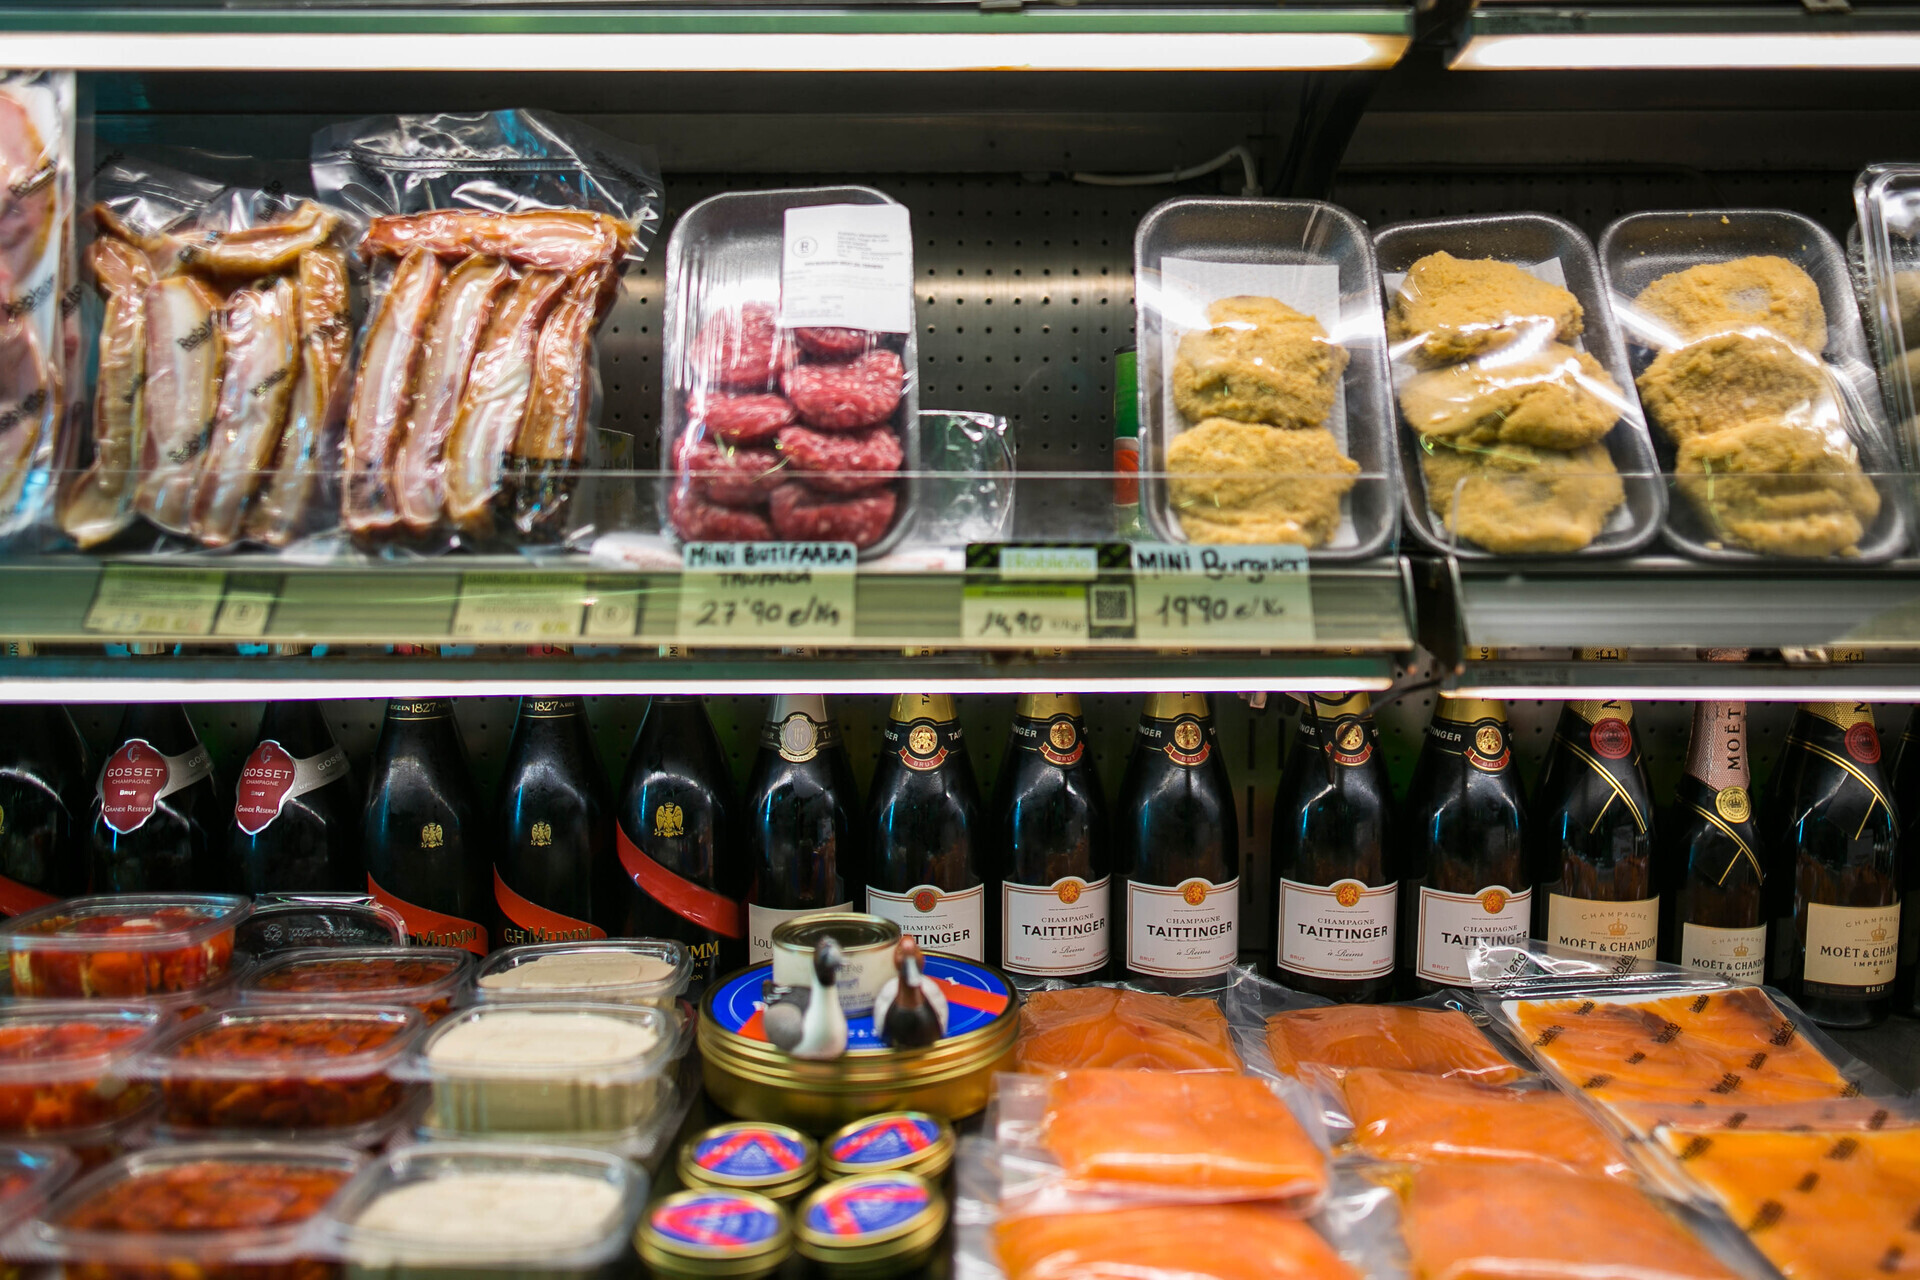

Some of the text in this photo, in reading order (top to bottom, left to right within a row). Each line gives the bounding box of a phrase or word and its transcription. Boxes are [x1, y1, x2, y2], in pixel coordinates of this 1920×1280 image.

[411, 702, 436, 714] 1827
[534, 701, 558, 712] 1827
[1727, 708, 1742, 771] MOËT
[913, 759, 935, 767] BRUT
[1056, 754, 1076, 762] BRUT
[1340, 755, 1362, 763] BRUT
[1481, 760, 1503, 768] BRUT
[107, 767, 163, 778] GOSSET
[243, 768, 292, 780] GOSSET
[1041, 912, 1094, 923] CHAMPAGNE
[1166, 915, 1221, 925] CHAMPAGNE
[1581, 911, 1648, 921] CHAMPAGNE
[1317, 917, 1375, 926] CHAMPAGNE
[899, 922, 954, 932] HAMPAGNE
[1021, 917, 1105, 937] TAITTINGER
[1146, 921, 1233, 938] TAITTINGER
[1297, 922, 1388, 940] TAITTINGER
[1463, 924, 1518, 933] CHAMPAGNE
[753, 935, 774, 948] LOU
[1441, 930, 1527, 947] TAITTINGER
[1559, 935, 1656, 952] MOËT & CHANDON
[1059, 945, 1086, 954] Reims
[1184, 947, 1211, 956] Reims
[1335, 948, 1364, 957] Reims
[1820, 945, 1861, 958] MOËT
[1862, 949, 1870, 958] &
[1290, 953, 1306, 961] BRUT
[1431, 963, 1450, 971] BRUT
[1691, 956, 1725, 970] MOËT
[1726, 962, 1733, 971] &
[1865, 985, 1885, 993] BRUT
